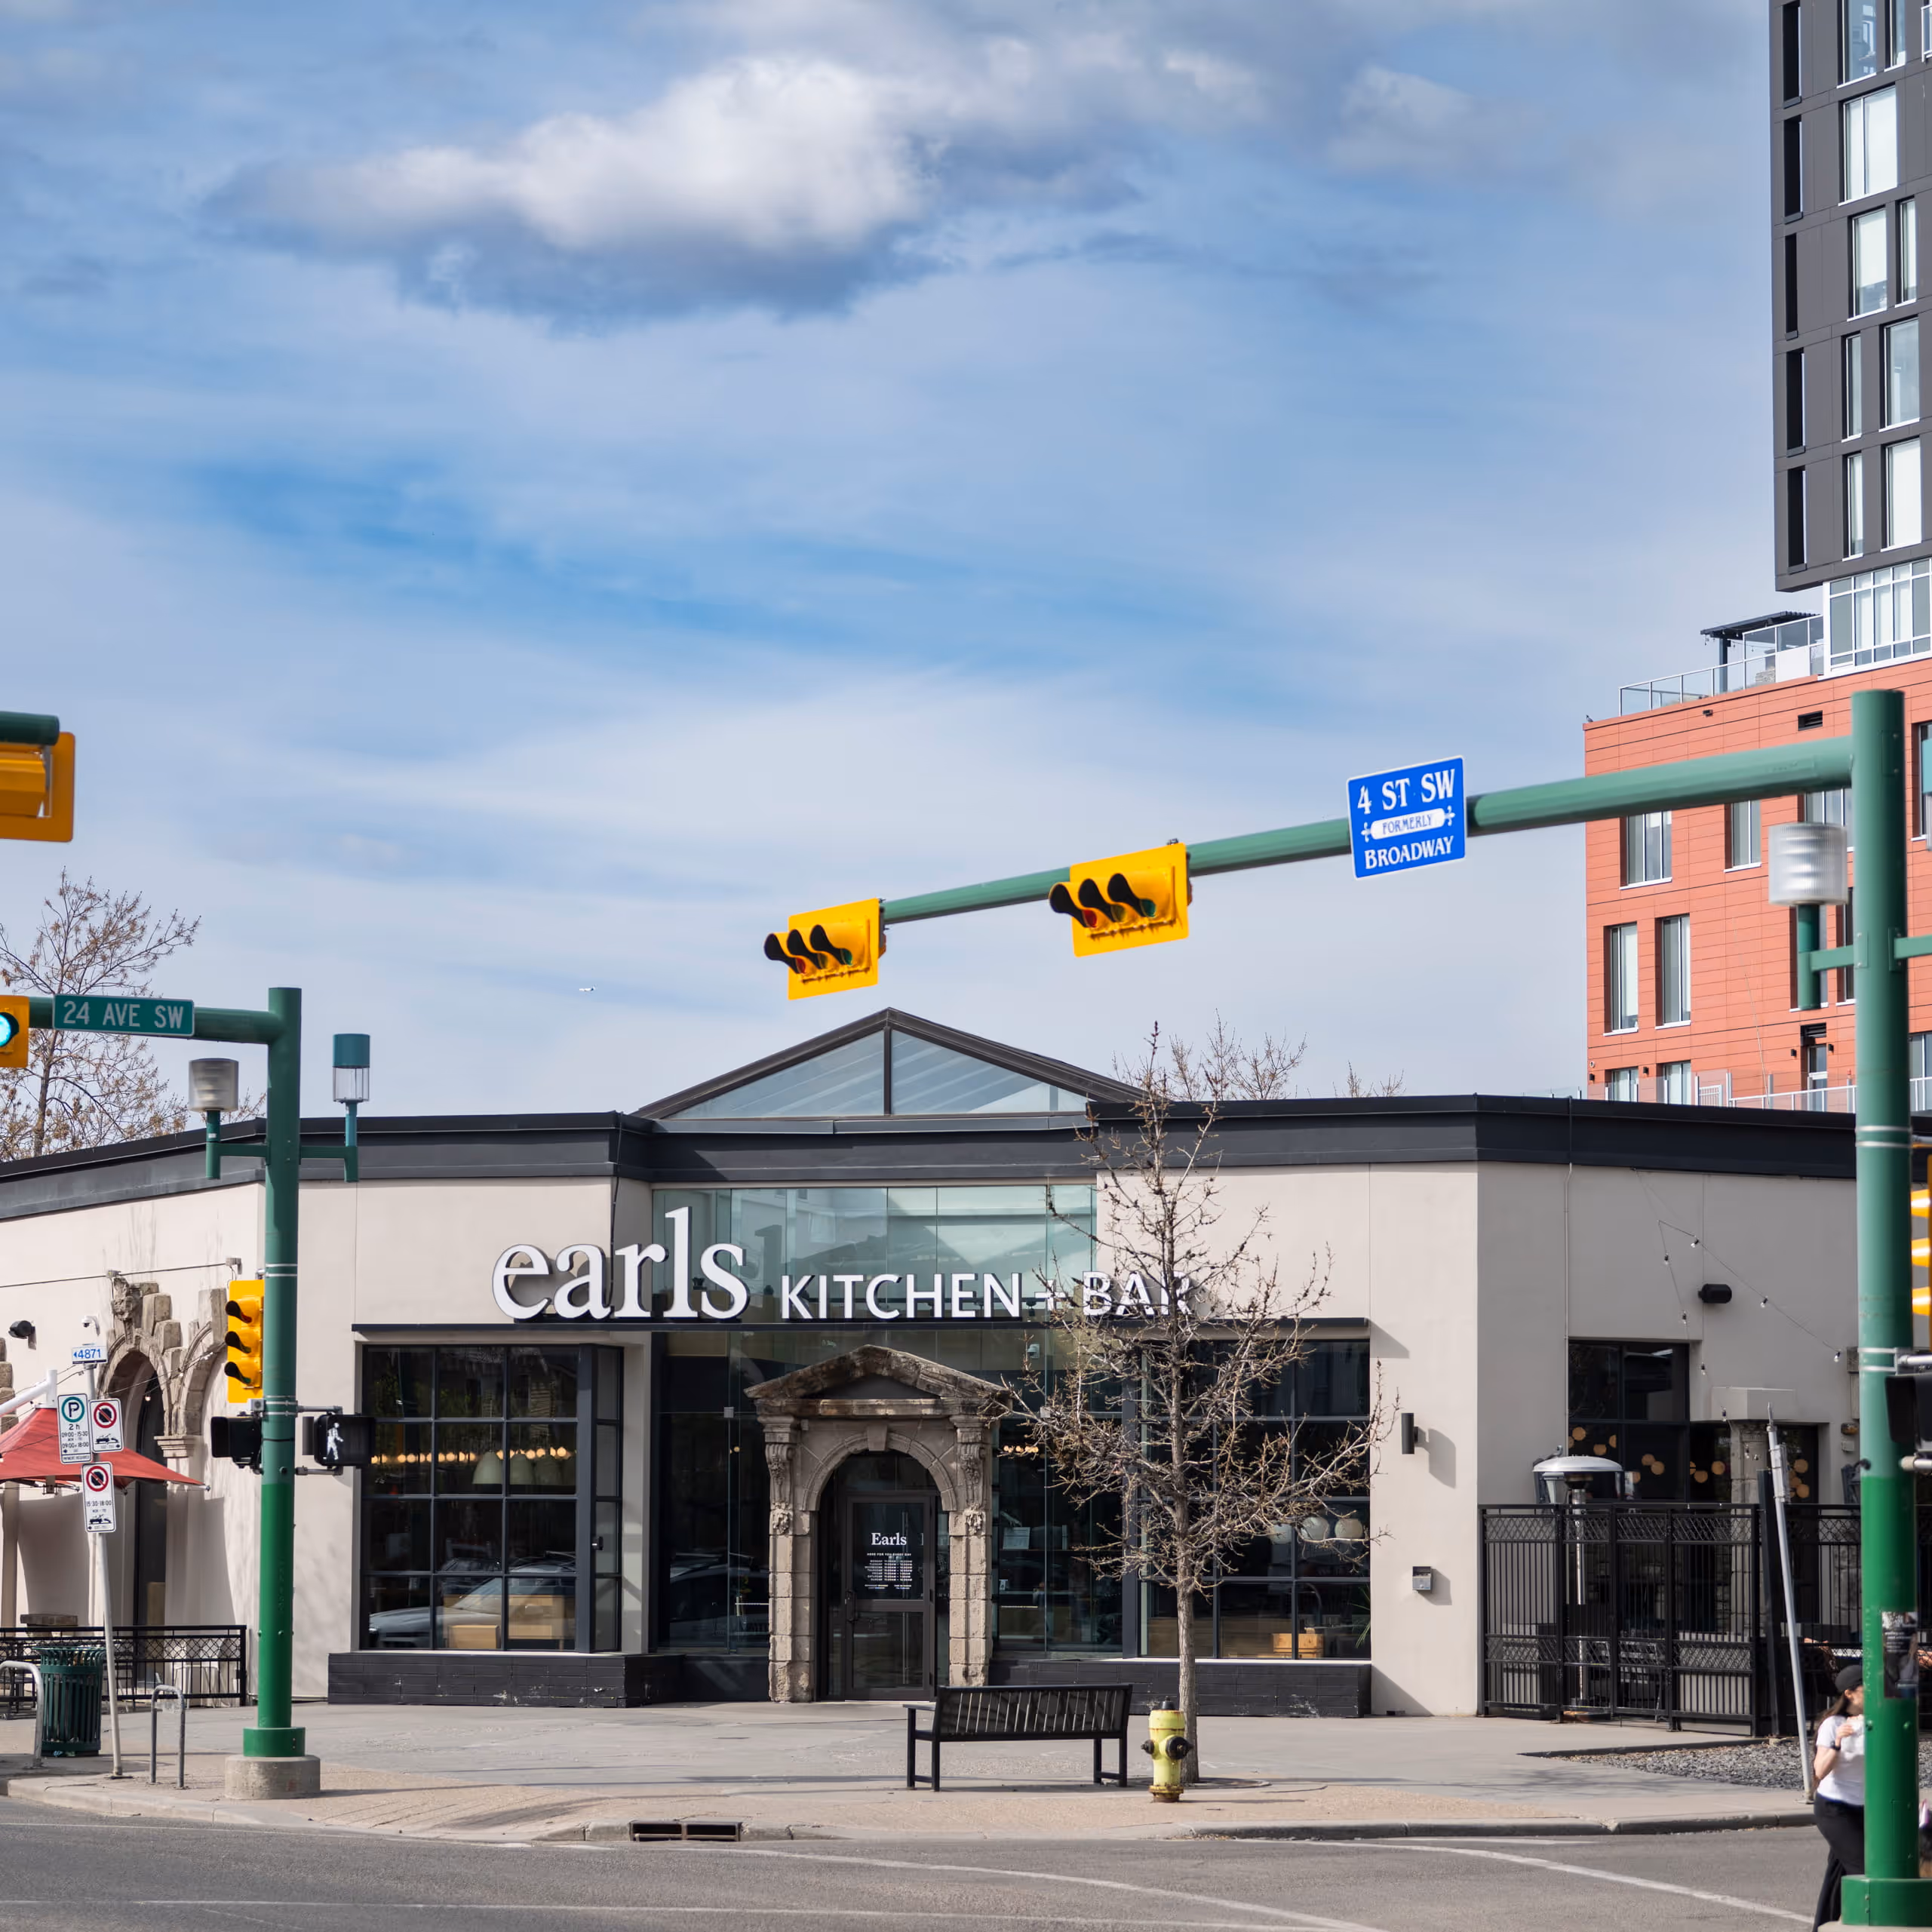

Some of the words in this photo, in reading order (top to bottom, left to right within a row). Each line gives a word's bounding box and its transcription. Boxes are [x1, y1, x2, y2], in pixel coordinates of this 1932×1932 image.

[1358, 785, 1372, 815] 4
[1382, 778, 1410, 810] ST
[1421, 769, 1455, 803] SW
[1382, 813, 1432, 835] FORMERLY
[1365, 835, 1454, 869] BROADWAY
[63, 1000, 90, 1024] 24
[103, 1003, 140, 1027] AVE
[154, 1005, 183, 1029] SW
[492, 1206, 750, 1319] earls
[781, 1273, 1022, 1319] KITCHEN
[1083, 1270, 1193, 1316] BAR
[78, 1348, 101, 1359] 4871
[871, 1532, 907, 1545] Earls
